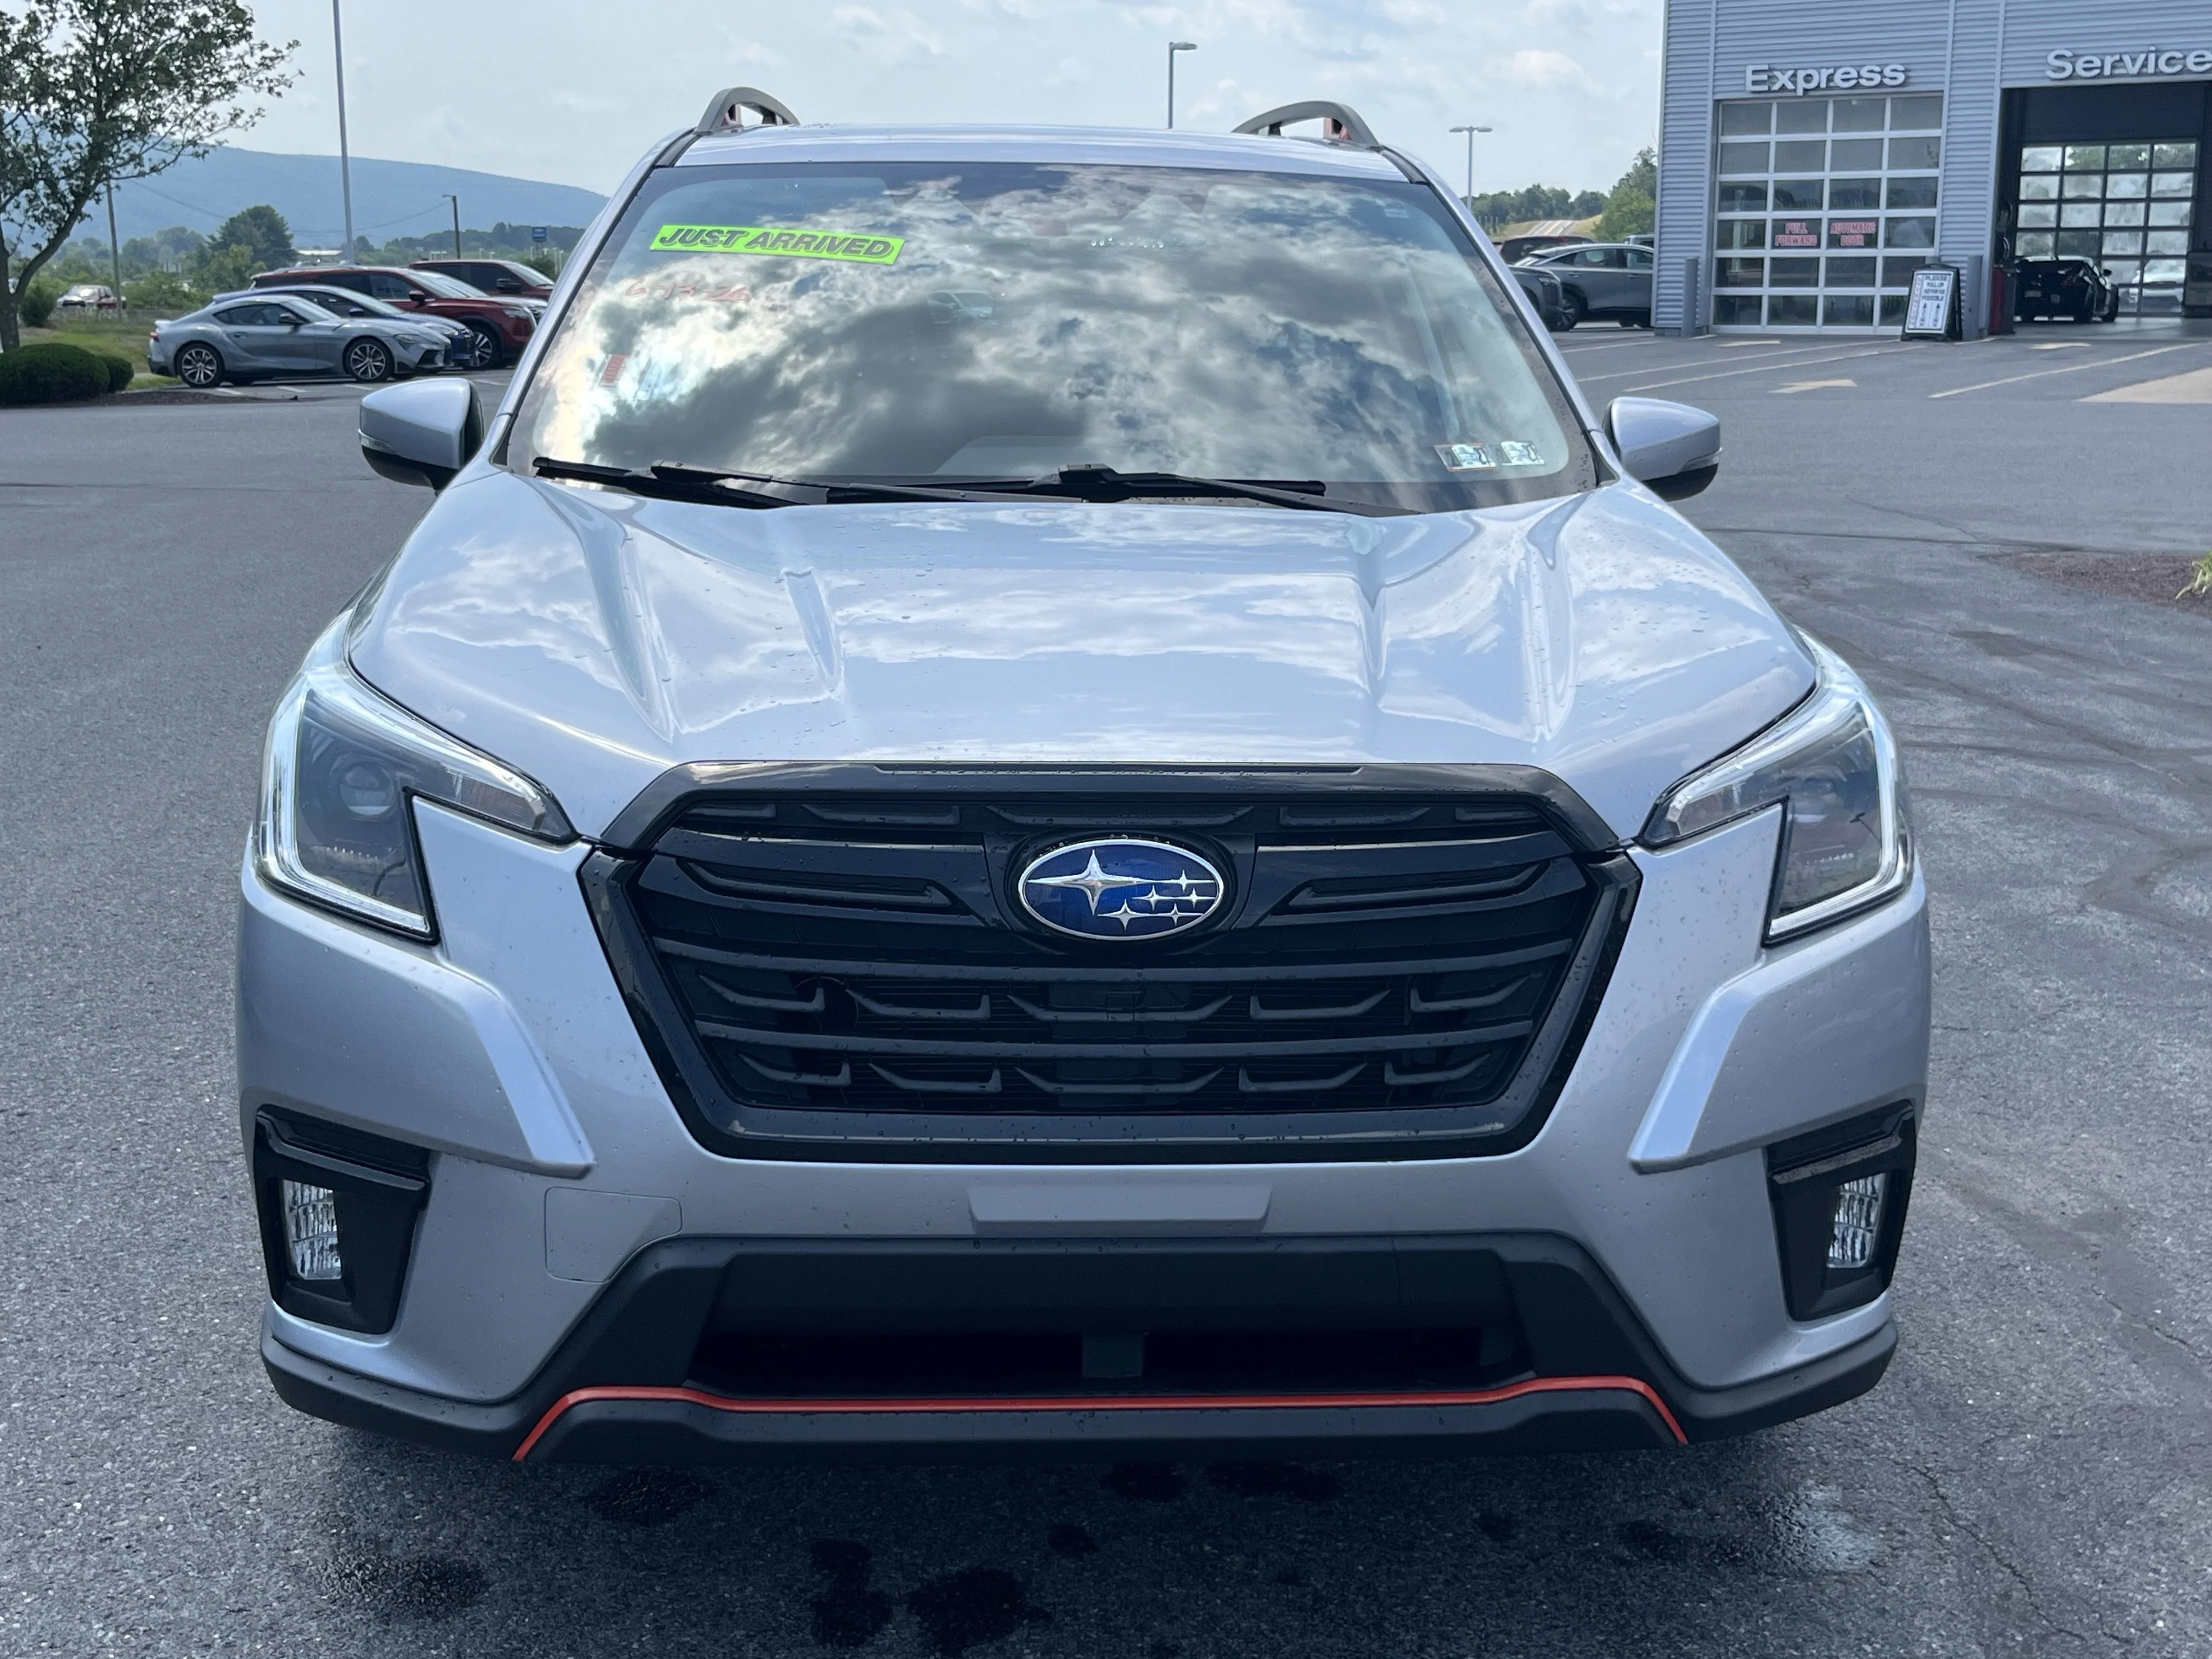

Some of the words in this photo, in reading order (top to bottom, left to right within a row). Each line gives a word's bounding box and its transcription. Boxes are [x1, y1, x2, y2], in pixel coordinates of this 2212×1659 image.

[2045, 46, 2212, 80] Service
[1745, 64, 1906, 95] Express
[1786, 222, 1808, 234] PULL
[1830, 222, 1876, 234] AUTOMATIC
[659, 228, 746, 248] JUST
[745, 232, 895, 258] ARRIVED
[1775, 235, 1817, 246] FORWARD
[1841, 234, 1864, 246] DOOR
